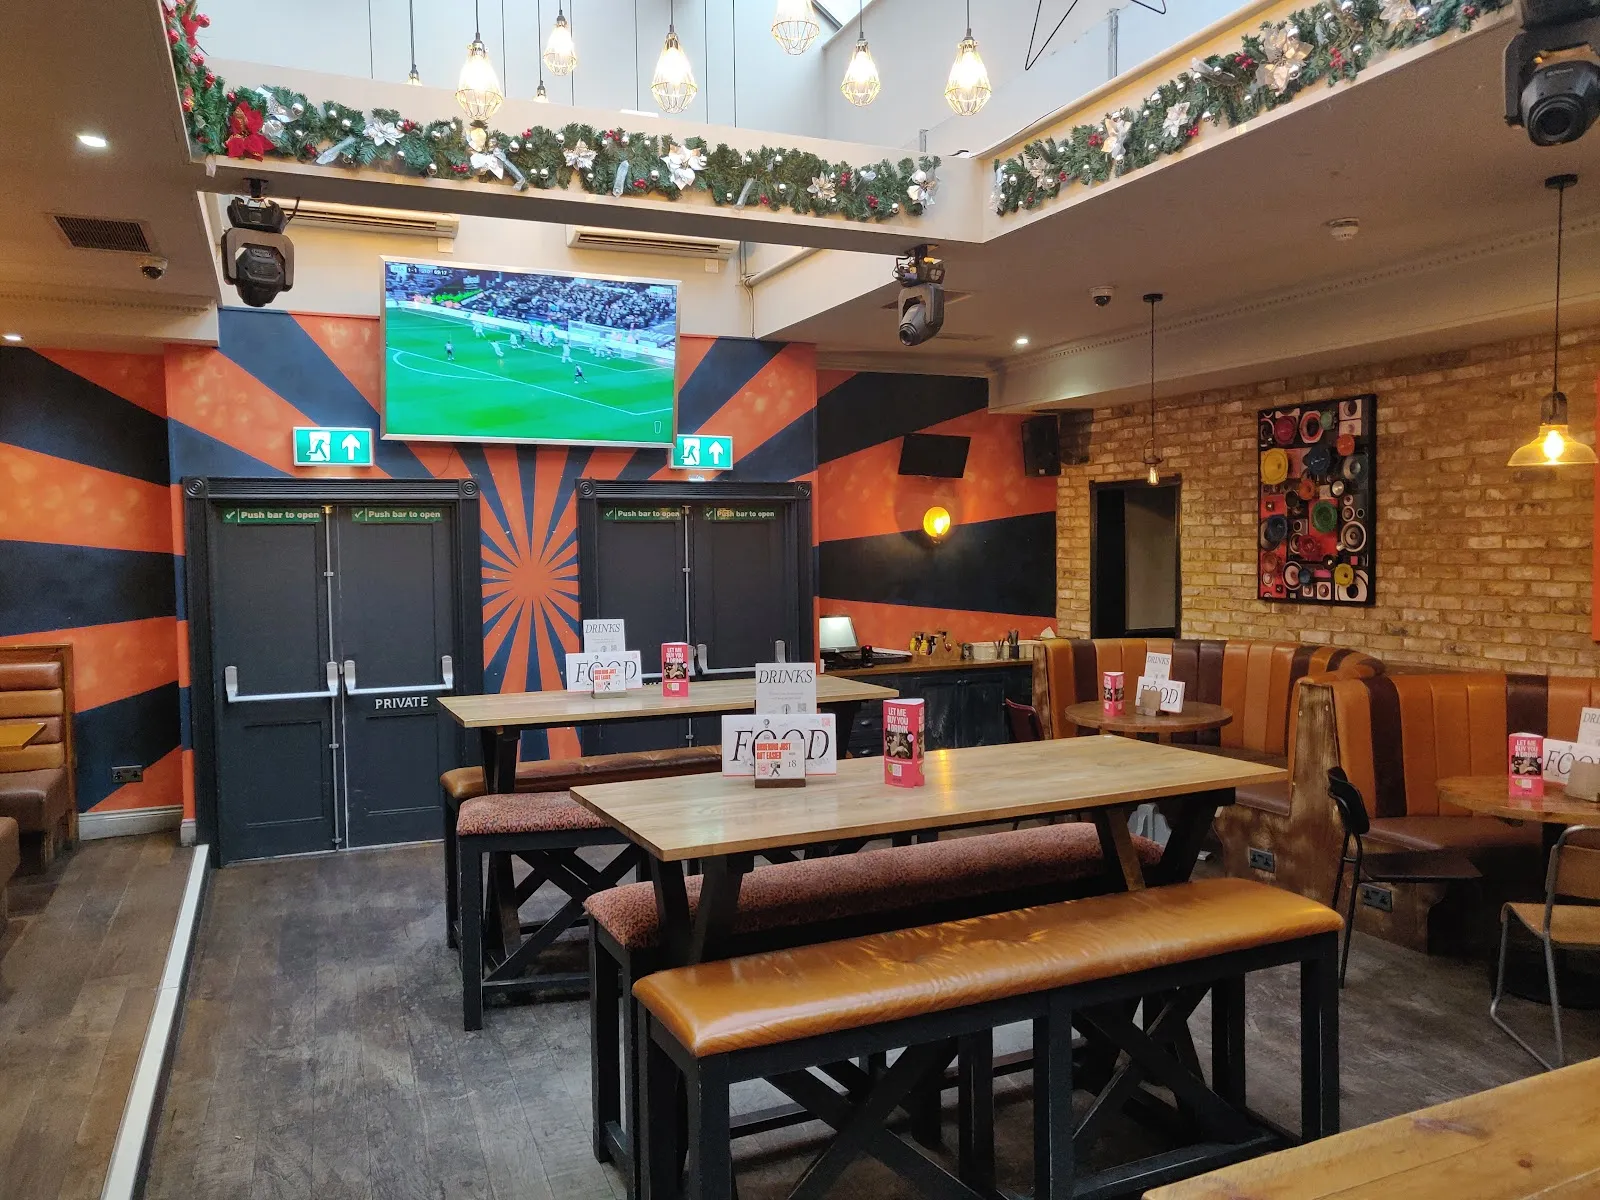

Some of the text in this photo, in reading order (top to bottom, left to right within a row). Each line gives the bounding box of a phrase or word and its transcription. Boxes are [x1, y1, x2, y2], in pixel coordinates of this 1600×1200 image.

[241, 511, 320, 520] Push bar to open
[368, 510, 391, 518] Push
[392, 510, 407, 518] bar
[419, 511, 441, 519] open
[585, 623, 622, 634] DRINKS
[1147, 655, 1170, 666] DRINKS
[758, 669, 813, 684] DRINKS
[375, 696, 429, 710] PRIVATE
[888, 707, 907, 717] LET ME
[886, 715, 909, 726] BUY YOU
[890, 724, 909, 734] DRINK
[787, 760, 797, 768] 18
